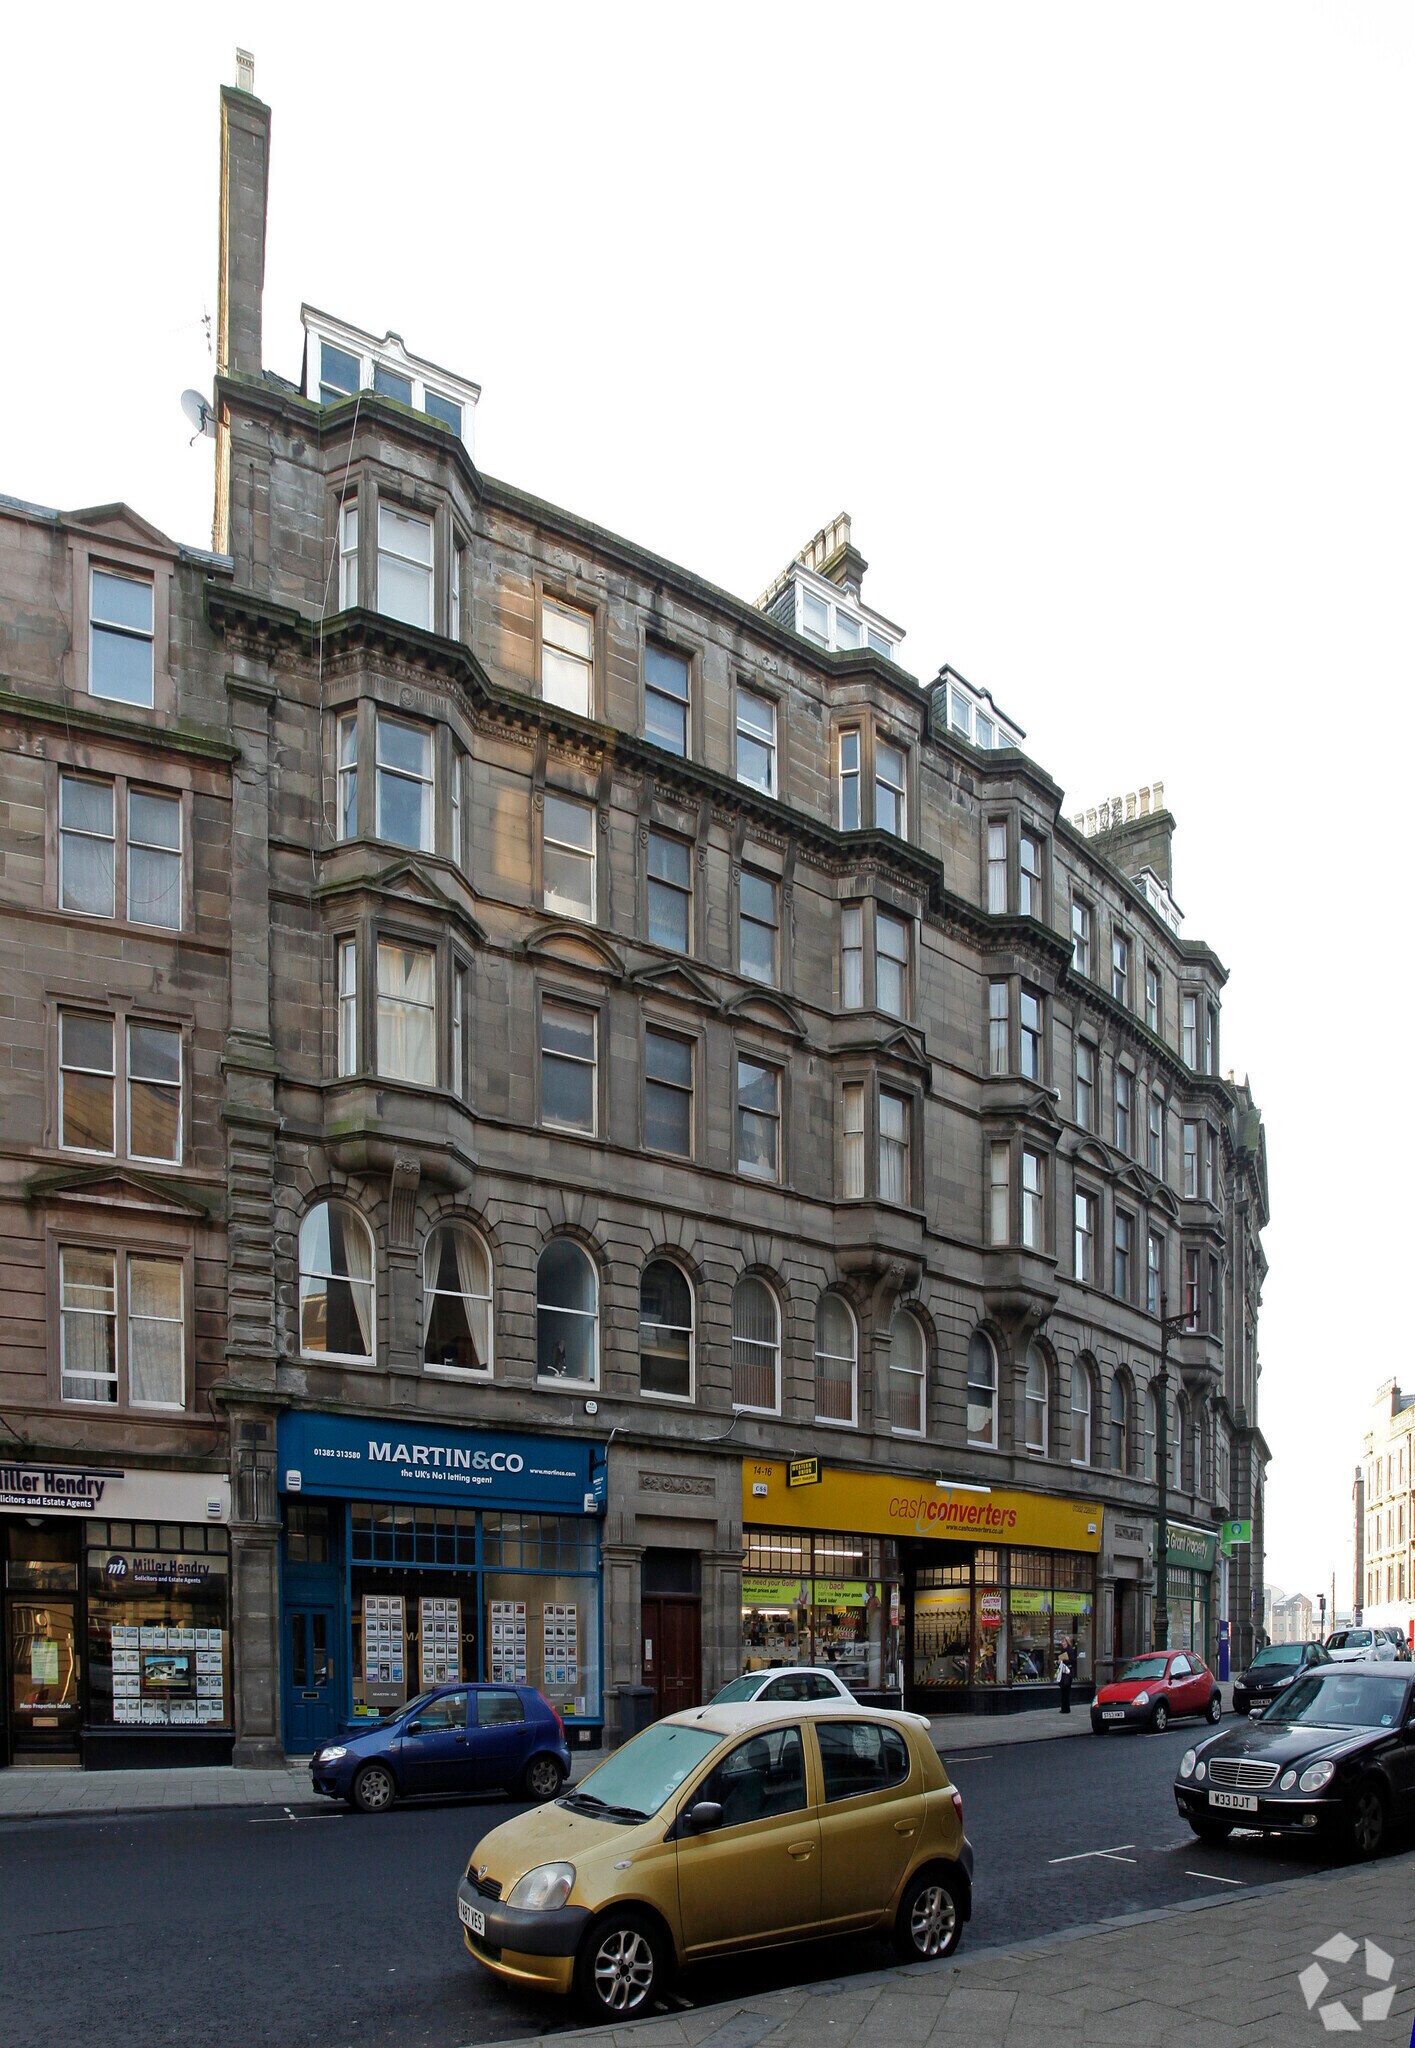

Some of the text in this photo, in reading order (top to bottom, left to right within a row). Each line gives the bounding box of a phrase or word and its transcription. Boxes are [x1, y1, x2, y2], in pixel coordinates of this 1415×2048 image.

[314, 1448, 360, 1459] 01382 313580
[368, 1441, 524, 1473] MARTIN&CO
[401, 1469, 413, 1478] the
[414, 1470, 430, 1479] UK's
[447, 1472, 470, 1484] letting
[471, 1476, 492, 1484] agent
[529, 1468, 576, 1477] www.martinco.com
[0, 1469, 105, 1502] iller Hendry
[27, 1497, 41, 1505] and
[42, 1498, 65, 1506] Estate
[66, 1499, 92, 1508] Agents
[133, 1559, 210, 1577] Miller Hendry
[134, 1574, 158, 1582] Solicitors
[829, 1582, 845, 1590] back
[1232, 1795, 1250, 1808] DJT
